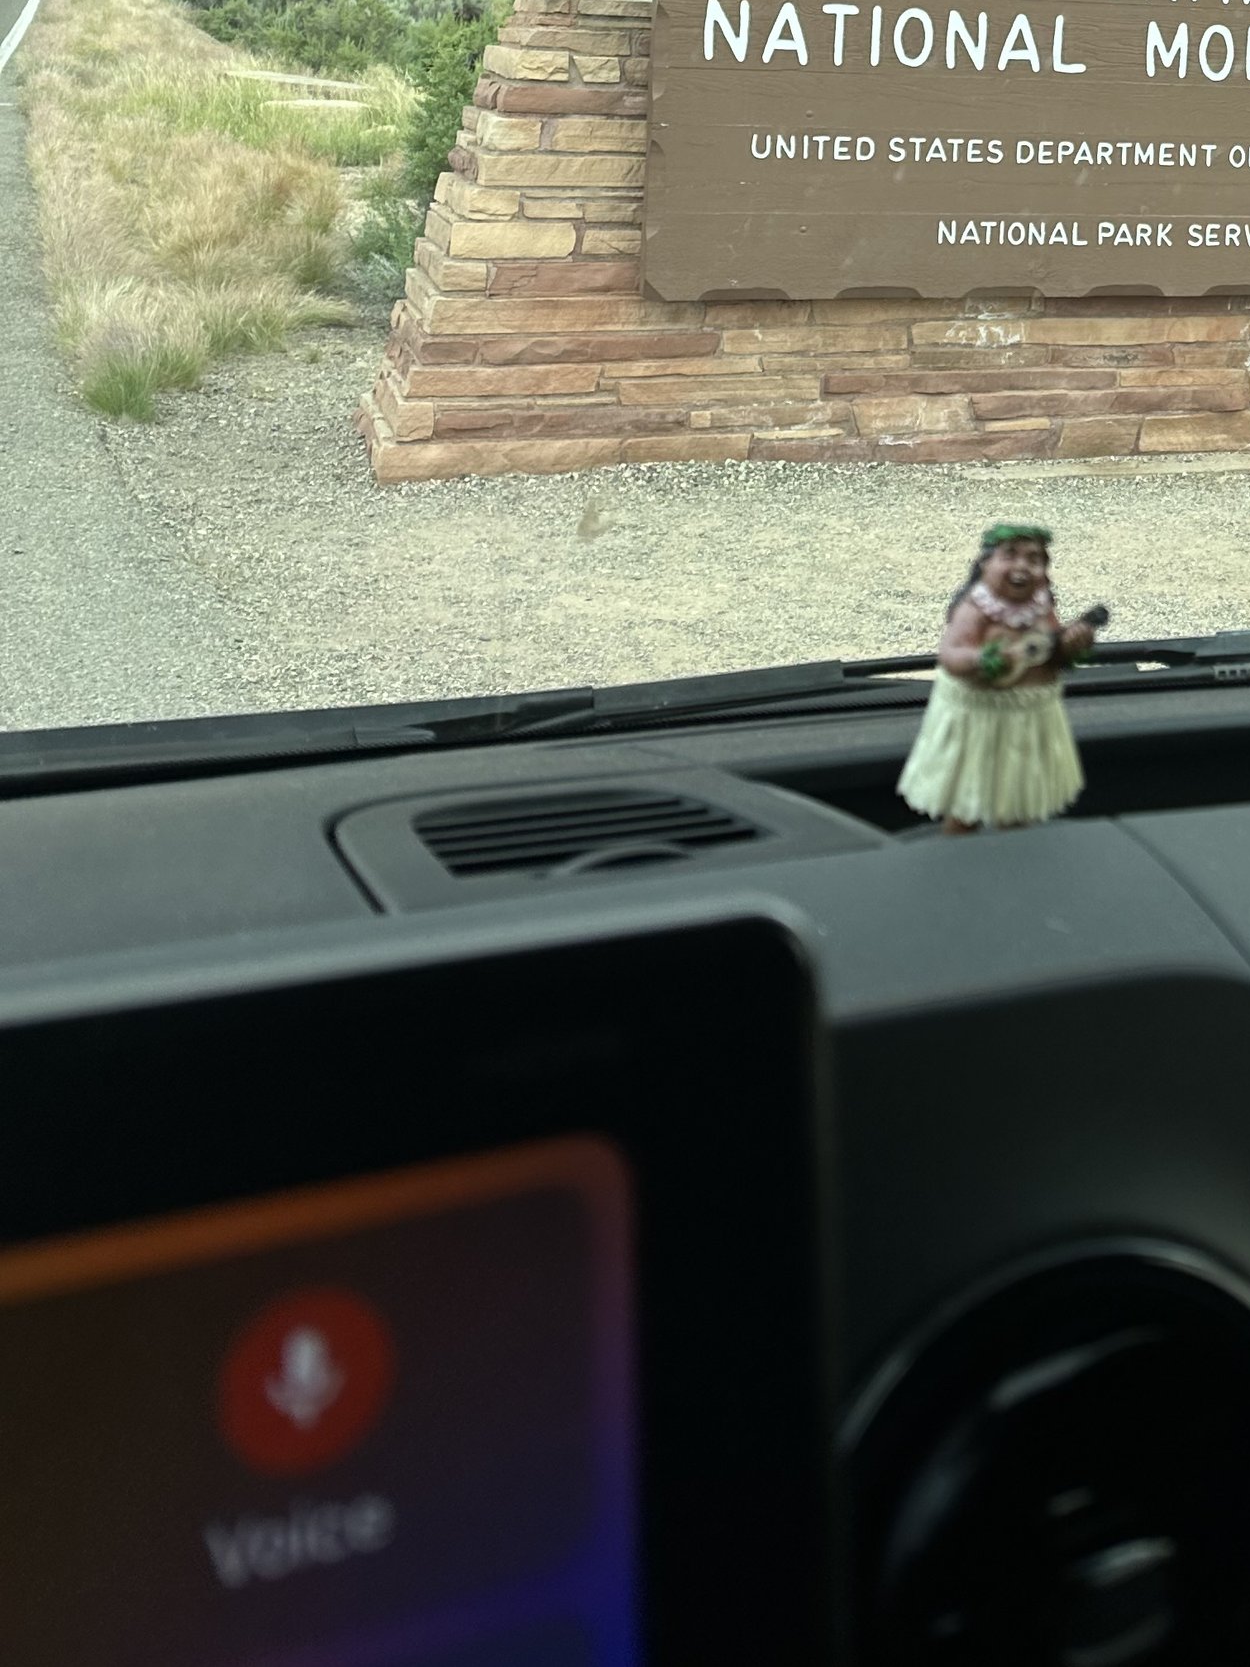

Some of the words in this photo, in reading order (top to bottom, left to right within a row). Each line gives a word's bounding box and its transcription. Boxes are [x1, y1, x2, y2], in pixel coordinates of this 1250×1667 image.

[750, 132, 877, 162] UNITED
[887, 136, 1005, 165] STATES
[1015, 139, 1218, 169] DEPARTMENT
[936, 219, 1089, 247] NATIONAL
[1097, 220, 1174, 248] PARK
[204, 1491, 396, 1589] Voice
